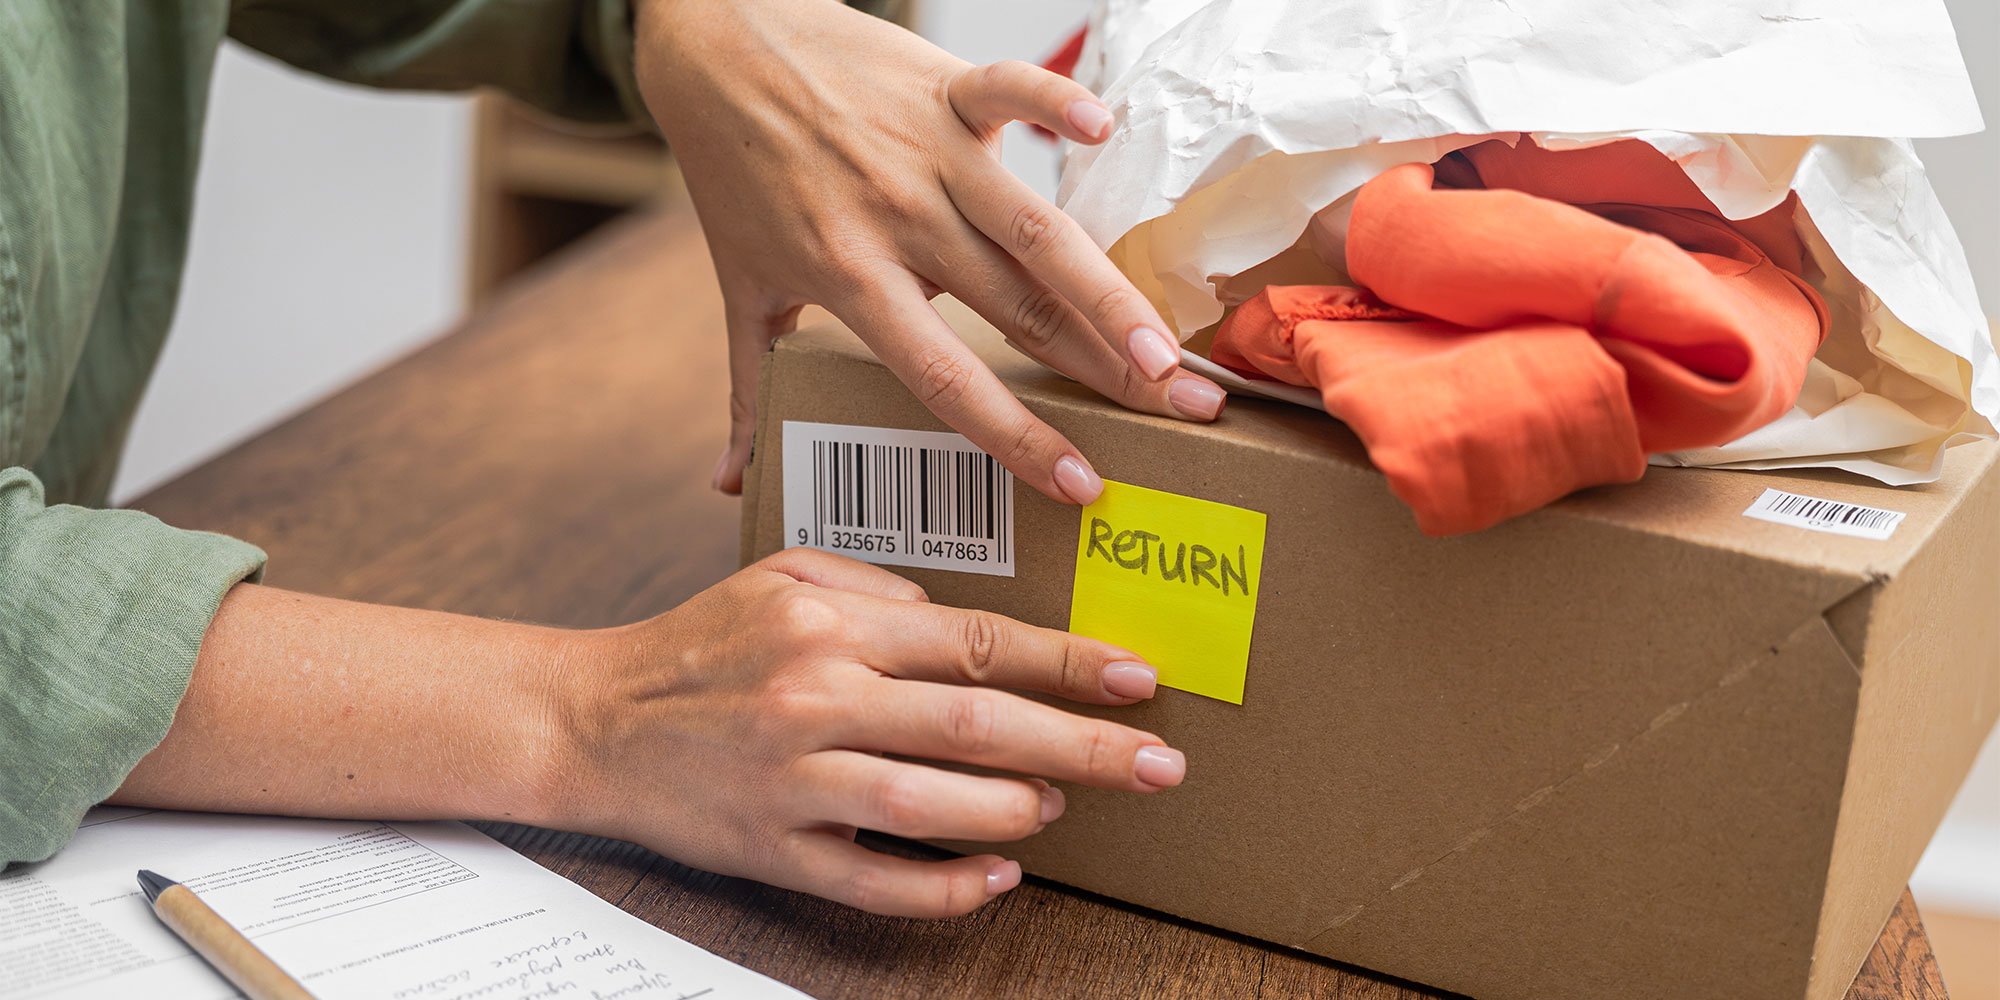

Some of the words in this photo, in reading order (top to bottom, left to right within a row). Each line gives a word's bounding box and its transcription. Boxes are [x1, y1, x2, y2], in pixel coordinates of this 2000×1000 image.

[797, 527, 808, 546] 9
[831, 531, 896, 553] 325675
[922, 539, 988, 562] 047863
